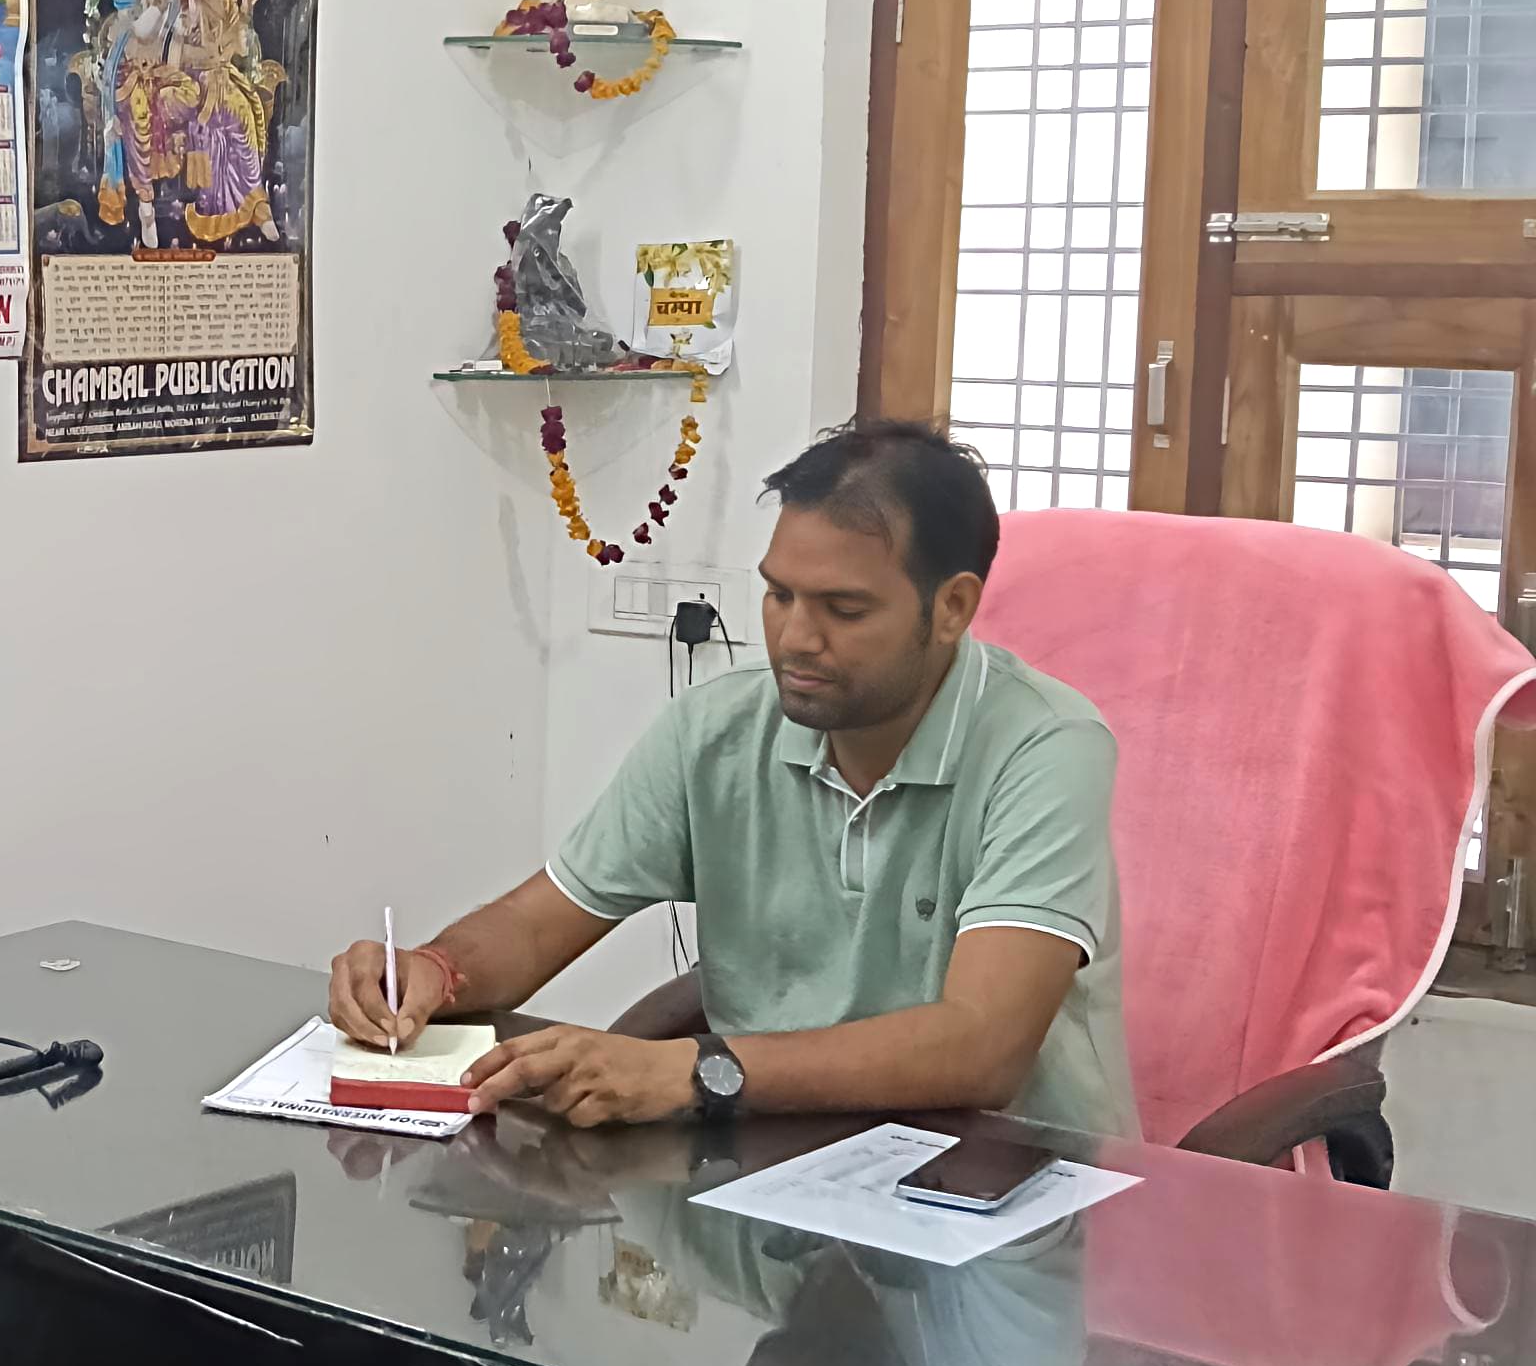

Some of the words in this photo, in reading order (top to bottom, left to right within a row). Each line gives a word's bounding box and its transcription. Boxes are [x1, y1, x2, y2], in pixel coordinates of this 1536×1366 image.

[655, 300, 703, 315] चम्पा
[42, 364, 149, 408] CHAMBAL
[155, 356, 295, 397] PUBLICATION
[270, 1100, 386, 1121] INTERNATIONAL
